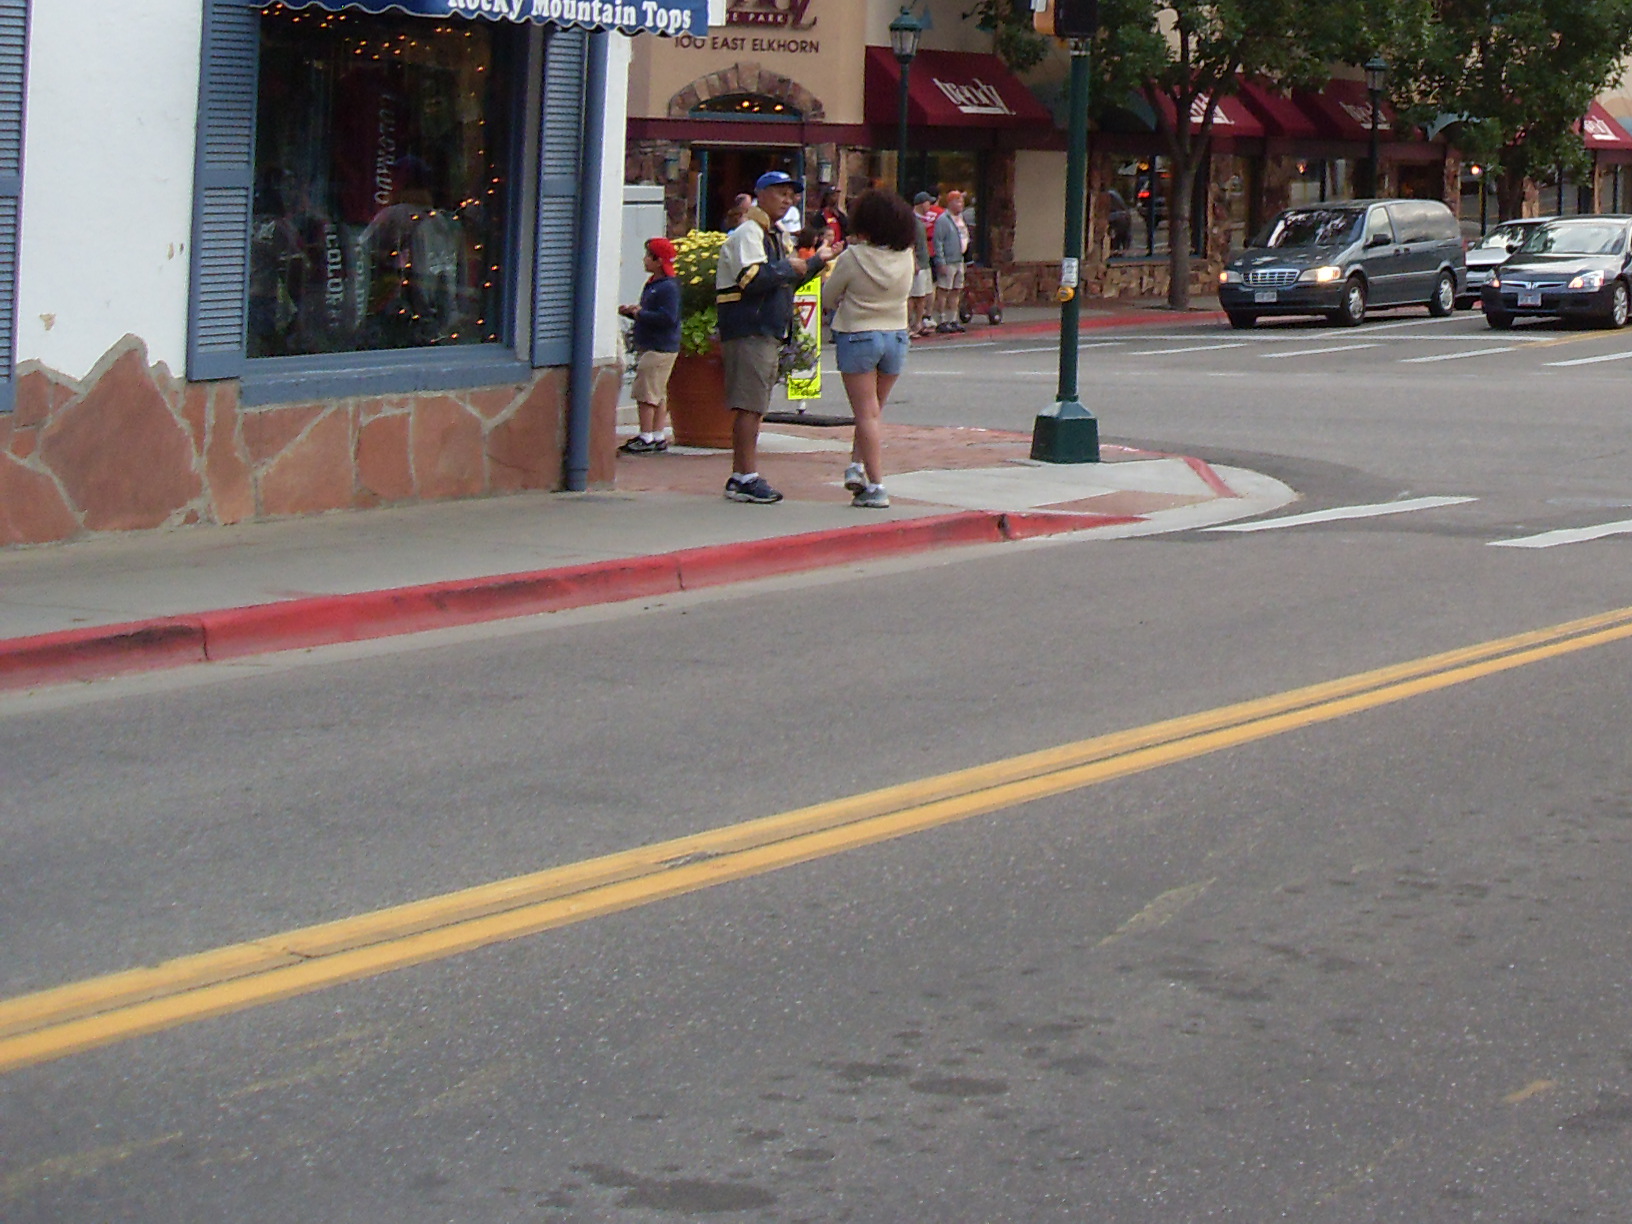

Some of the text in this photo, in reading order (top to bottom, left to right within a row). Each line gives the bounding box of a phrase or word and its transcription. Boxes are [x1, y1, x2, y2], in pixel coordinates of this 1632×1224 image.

[641, 0, 692, 34] Tops
[711, 36, 746, 51] EAST
[751, 38, 820, 54] ELKHORN
